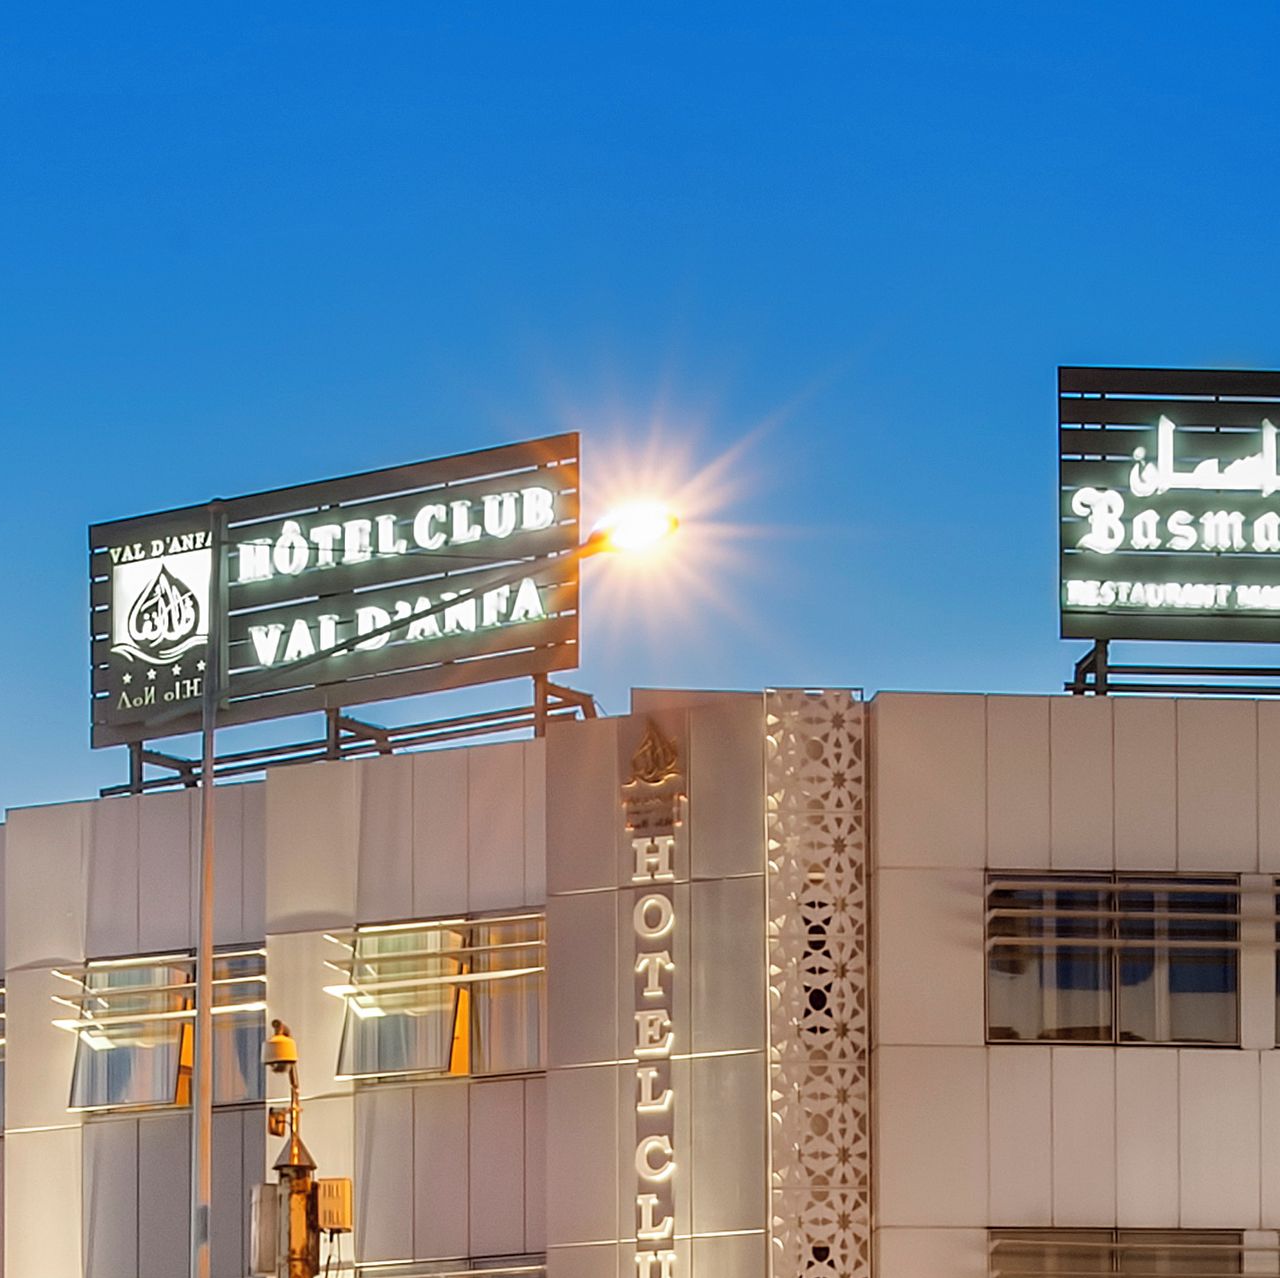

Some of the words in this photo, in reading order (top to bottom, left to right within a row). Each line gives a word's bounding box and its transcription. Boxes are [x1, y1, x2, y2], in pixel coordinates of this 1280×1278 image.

[110, 545, 146, 564] VAL
[237, 514, 407, 582] HÔTEL
[413, 487, 555, 549] CLUB
[248, 614, 348, 667] VAL
[354, 577, 548, 650] D'ANFA
[631, 836, 676, 1114] HOTEL
